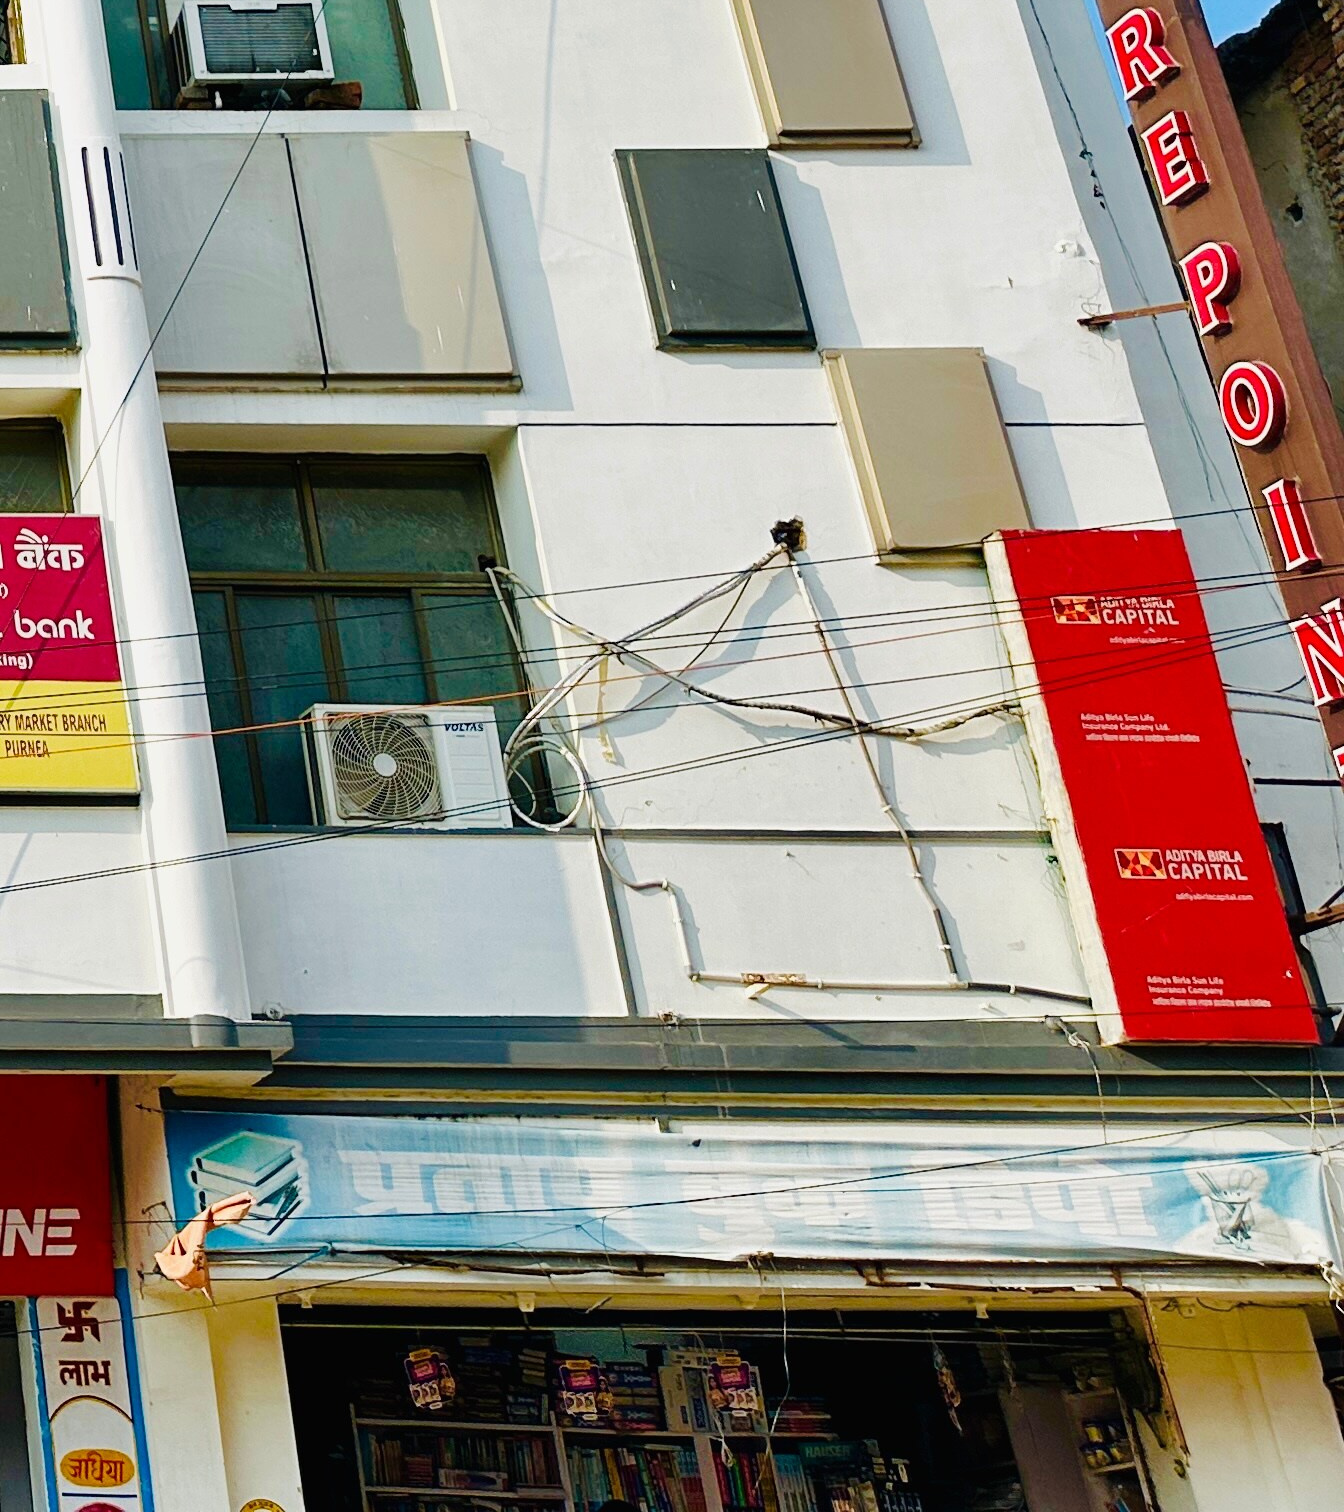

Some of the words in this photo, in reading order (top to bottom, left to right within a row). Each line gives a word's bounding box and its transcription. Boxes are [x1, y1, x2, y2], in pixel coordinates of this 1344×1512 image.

[1179, 241, 1344, 778] POIN
[14, 527, 85, 571] बैंक
[14, 609, 95, 640] bank
[1102, 609, 1179, 625] CAPITAL
[15, 713, 58, 731] MARKET
[62, 713, 107, 732] BRANCH
[444, 722, 484, 732] VOLTAS
[5, 740, 50, 759] PURNEA
[1165, 849, 1207, 862] ADITYA
[1208, 850, 1243, 863] BIRLA
[1168, 863, 1248, 881] CAPITAL
[59, 1360, 111, 1386] लाभ
